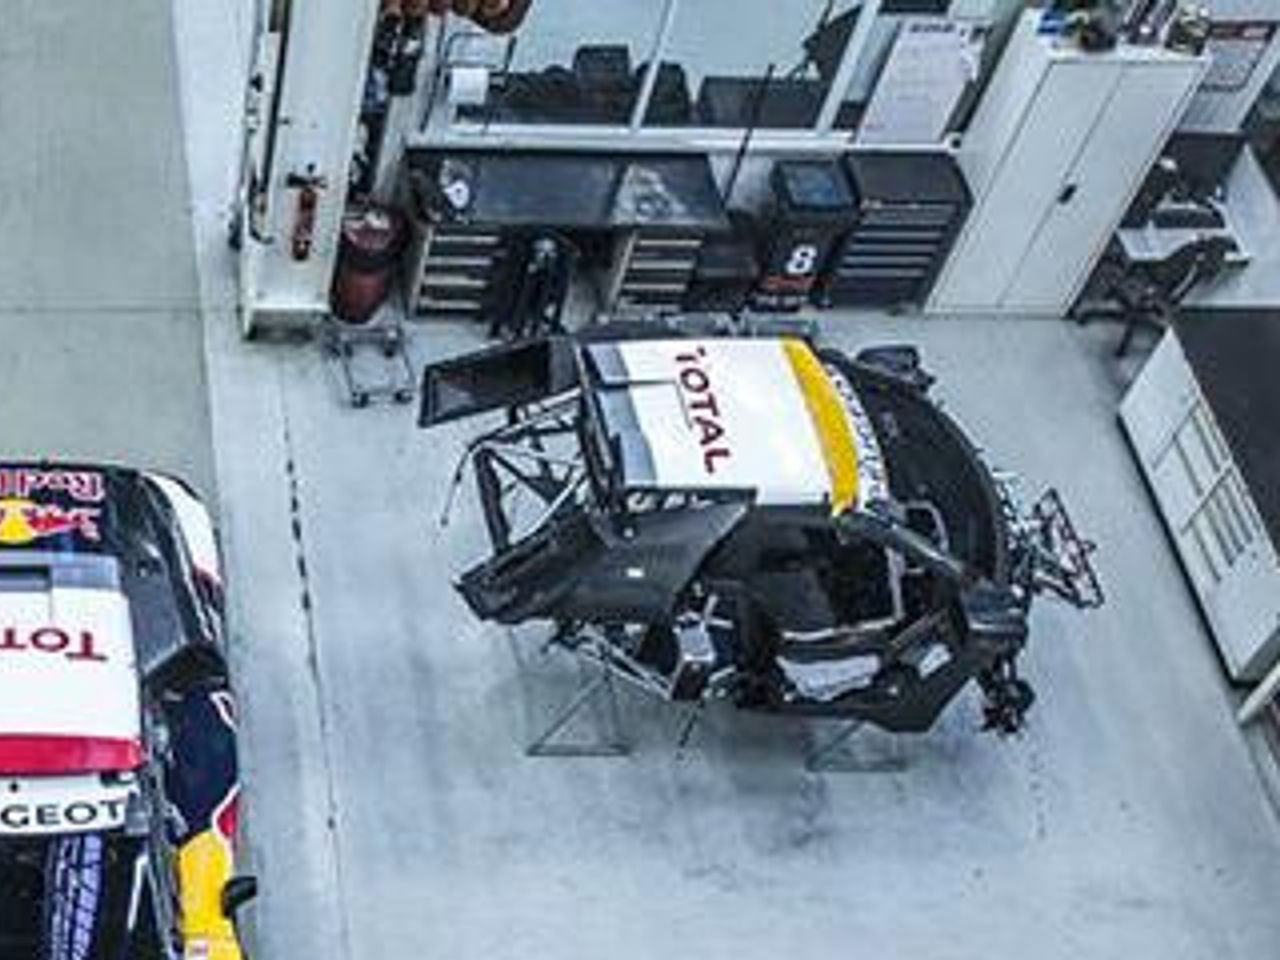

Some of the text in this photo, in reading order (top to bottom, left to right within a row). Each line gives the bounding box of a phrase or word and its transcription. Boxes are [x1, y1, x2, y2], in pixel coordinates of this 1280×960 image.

[786, 244, 818, 274] 8
[675, 345, 731, 476] TOTAL
[16, 470, 105, 501] Red
